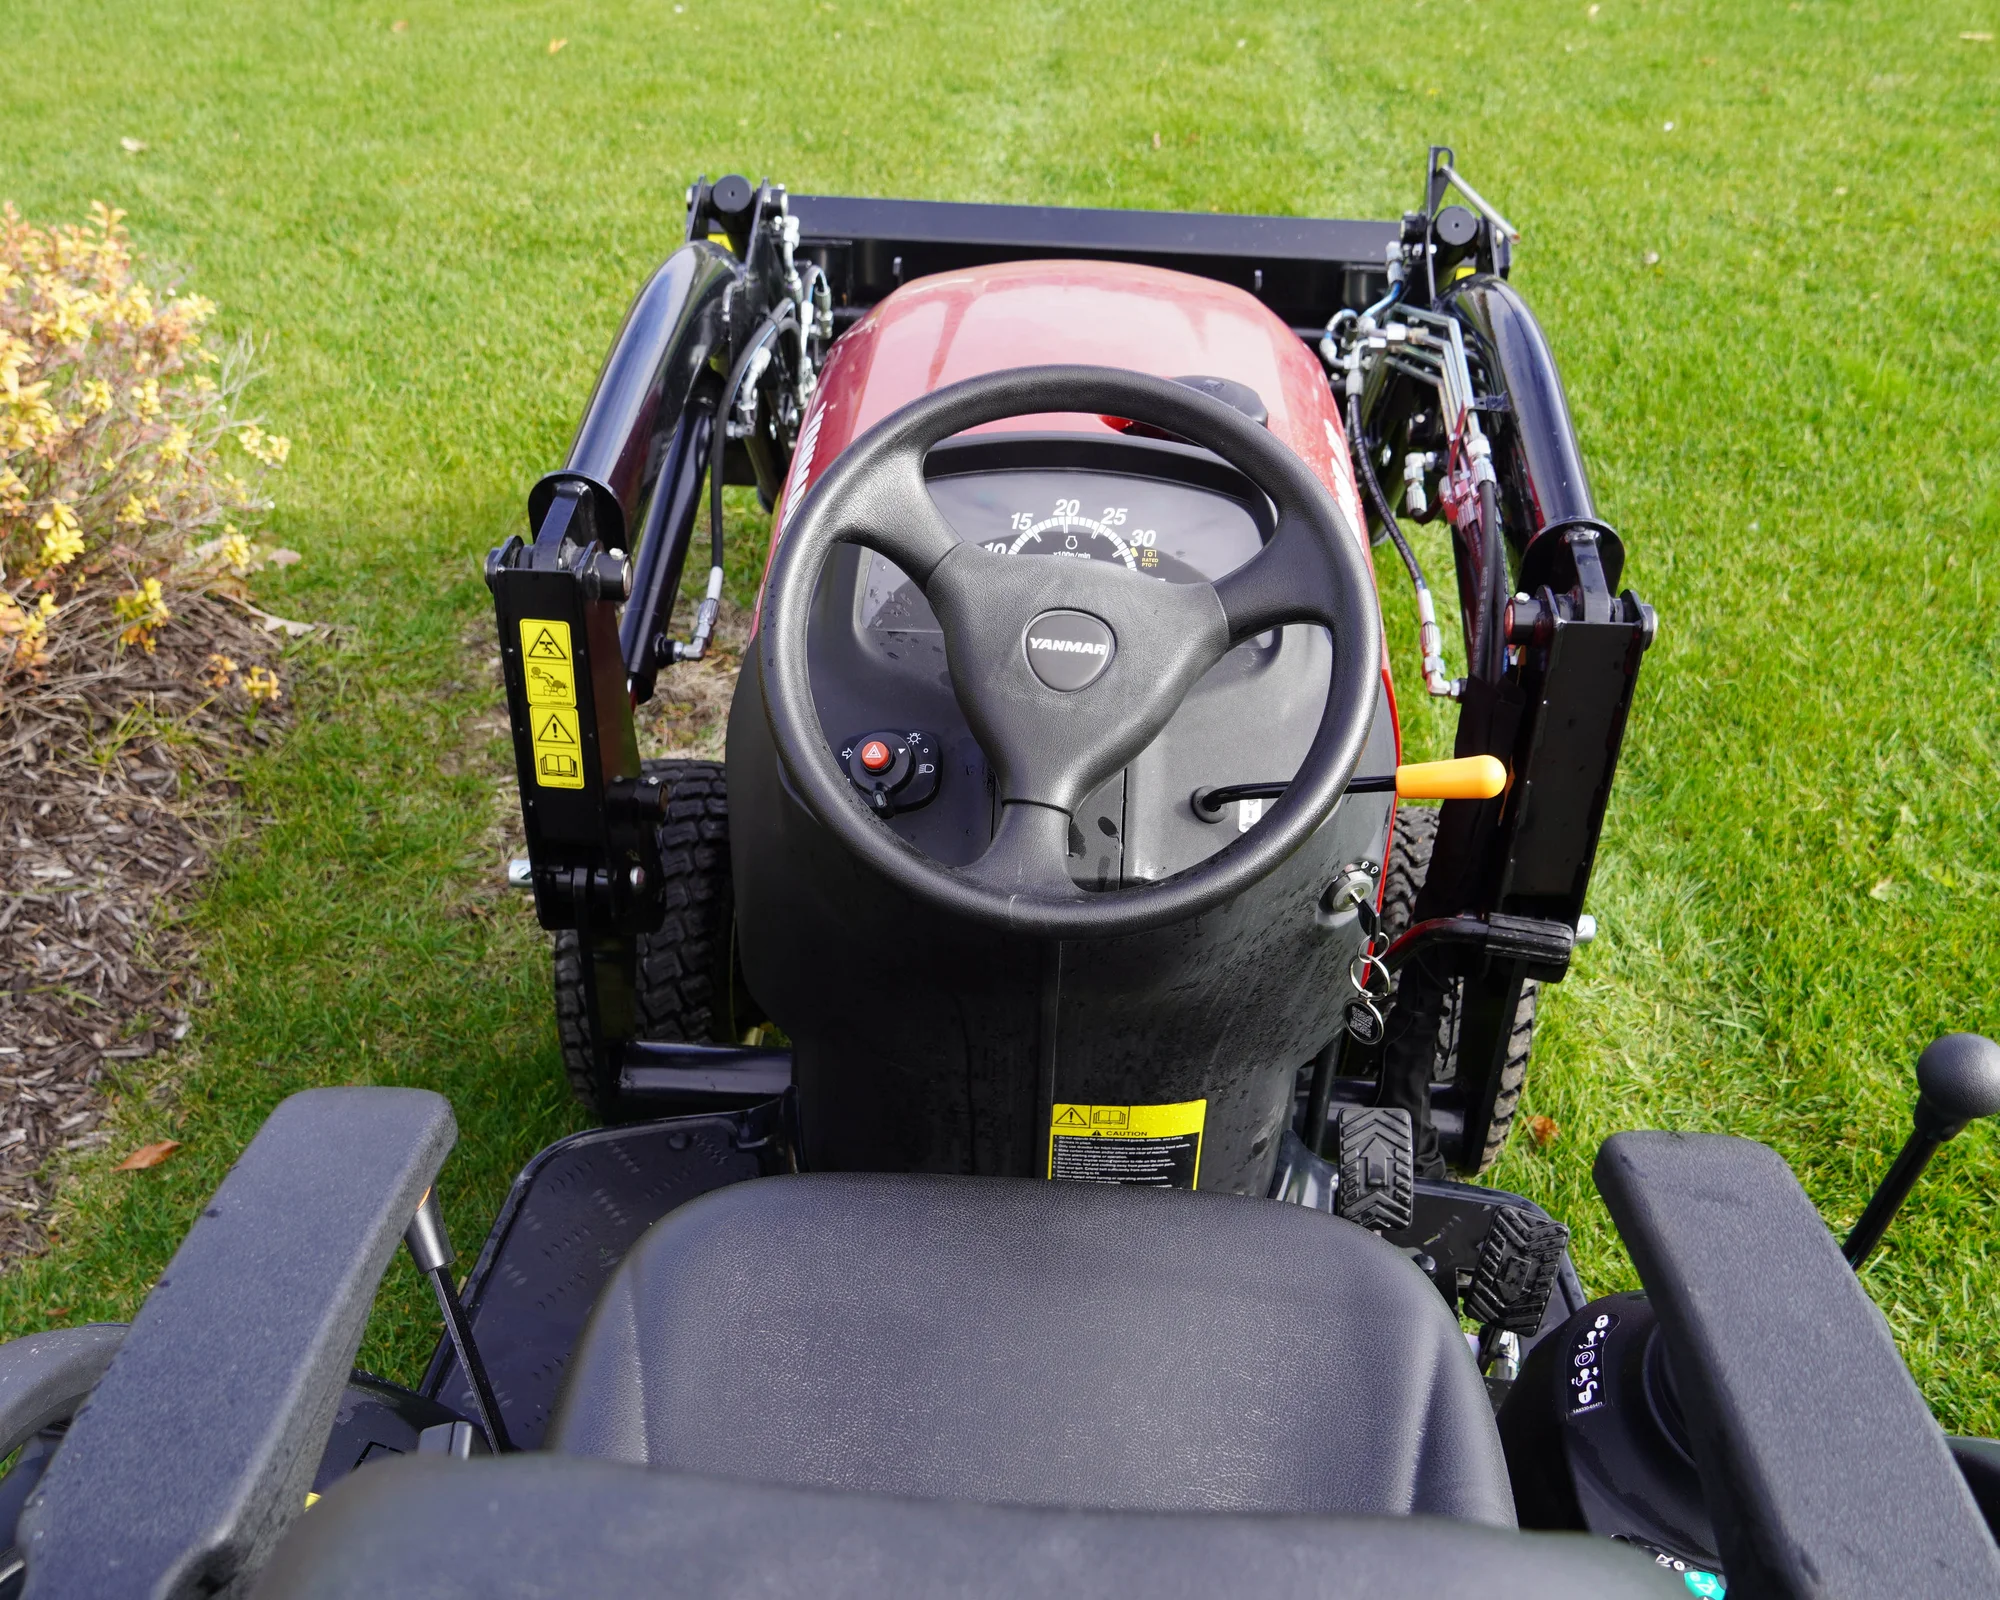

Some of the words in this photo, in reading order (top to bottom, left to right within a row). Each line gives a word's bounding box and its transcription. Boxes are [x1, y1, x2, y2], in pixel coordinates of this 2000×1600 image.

[1053, 499, 1080, 517] 20
[1102, 508, 1128, 525] 25
[1011, 512, 1034, 530] 15
[1130, 530, 1156, 547] 30
[1030, 637, 1107, 655] YANMAR
